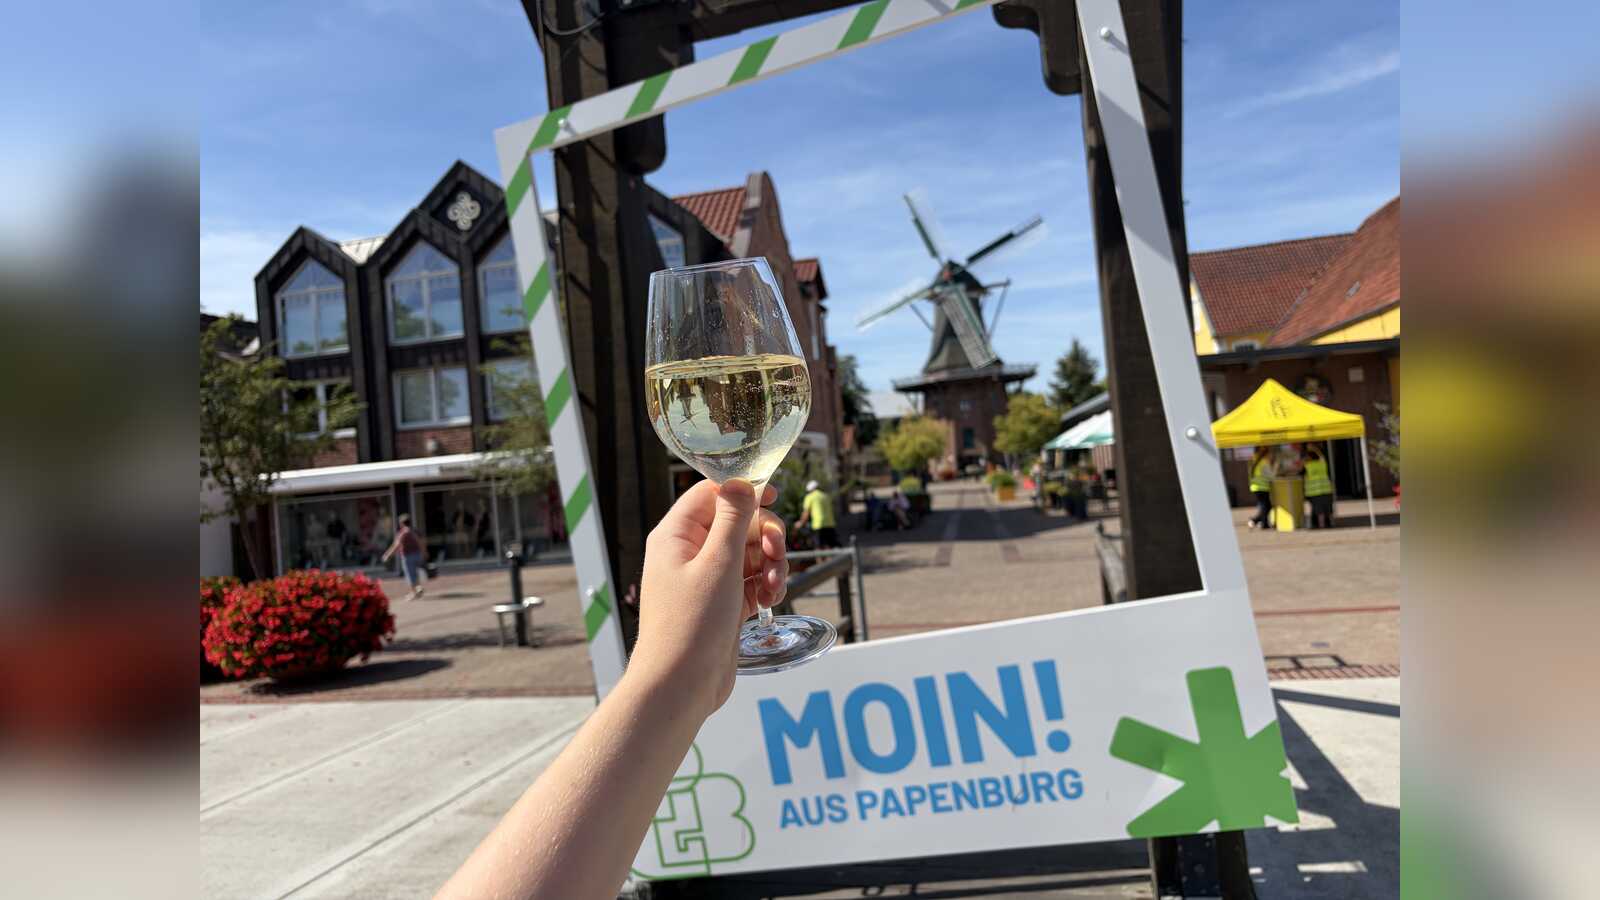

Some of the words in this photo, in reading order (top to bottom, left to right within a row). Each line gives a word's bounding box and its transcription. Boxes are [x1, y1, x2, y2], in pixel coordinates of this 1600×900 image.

[758, 659, 1071, 786] MOIN!
[779, 793, 848, 829] AUS
[856, 767, 1085, 822] PAPENBURG
